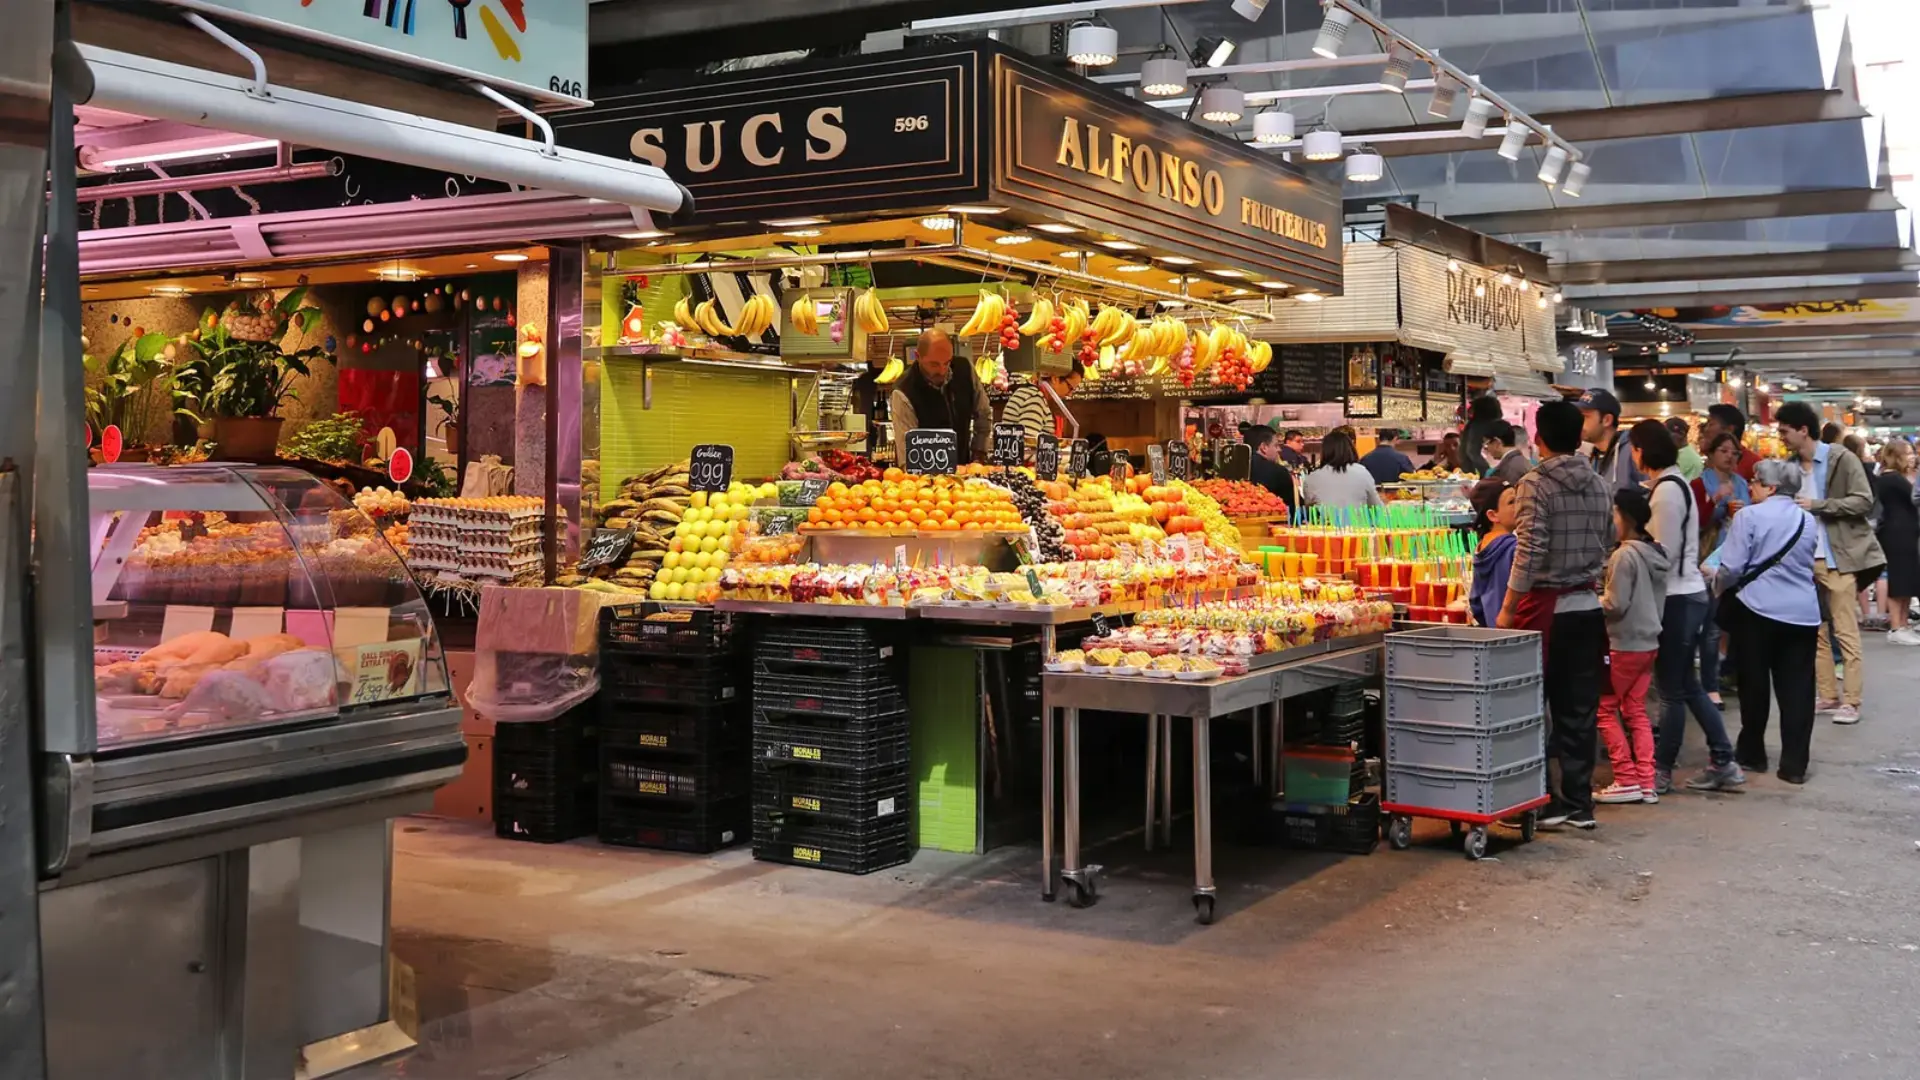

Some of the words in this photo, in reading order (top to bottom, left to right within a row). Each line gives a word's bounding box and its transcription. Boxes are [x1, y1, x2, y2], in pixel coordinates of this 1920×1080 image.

[550, 75, 582, 98] 646
[893, 115, 930, 133] 596
[629, 106, 847, 172] SUCS
[1056, 116, 1225, 217] ALFONSO
[1240, 197, 1327, 249] FRUITERIES
[640, 734, 668, 744] MORALES
[793, 746, 821, 757] MORALES
[640, 781, 667, 791] MORALES
[793, 796, 820, 807] MORALES
[793, 847, 821, 858] MORALES
